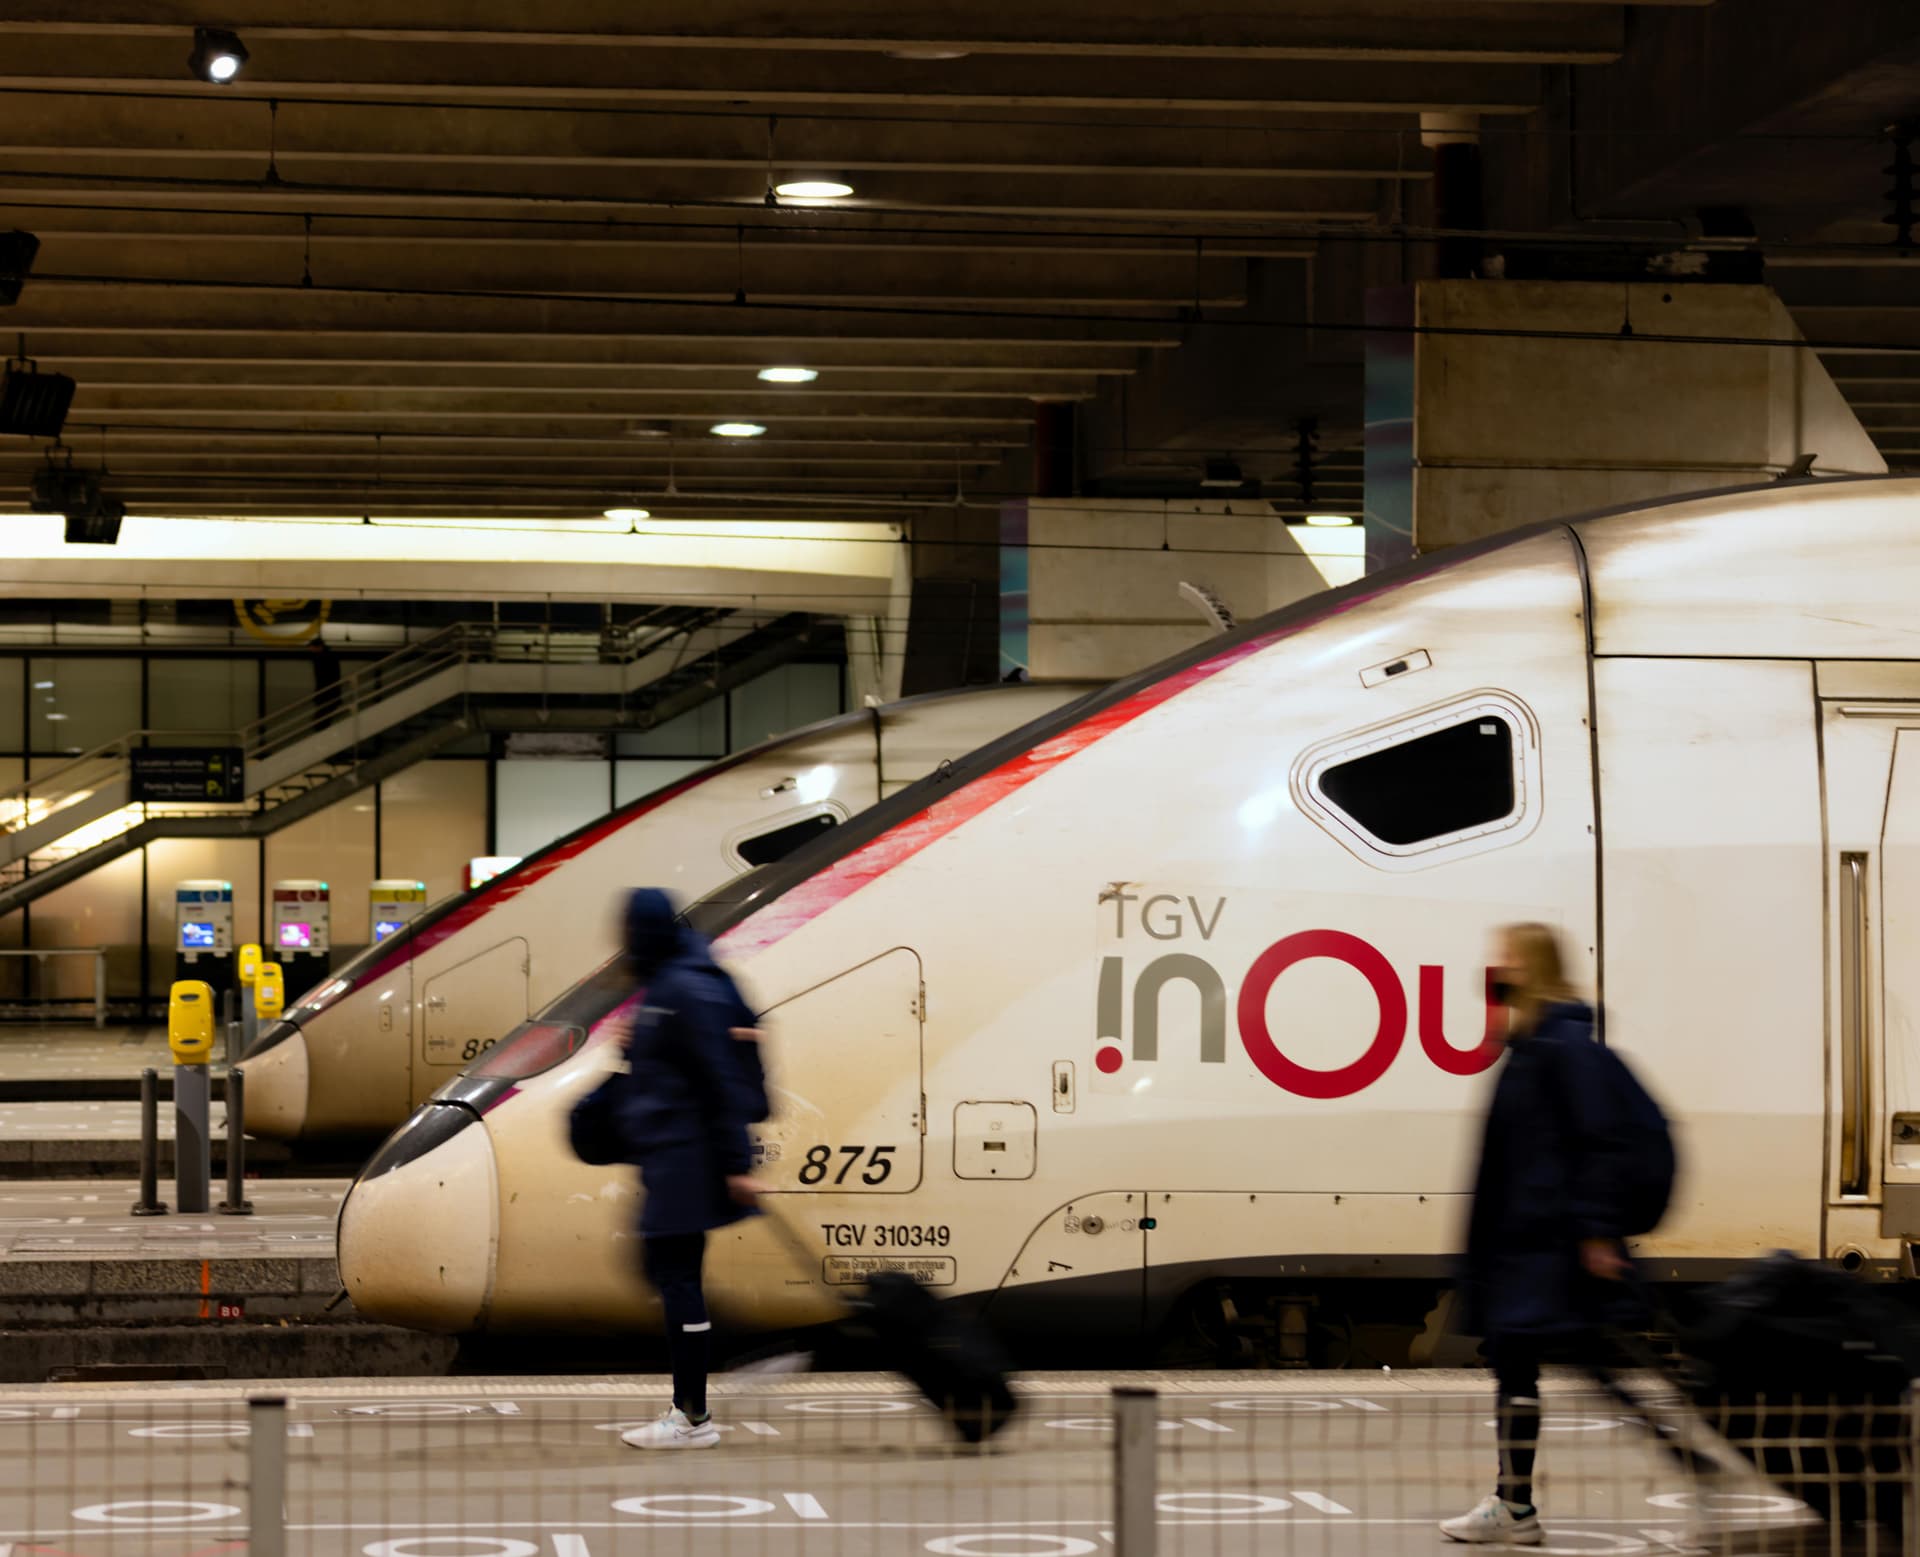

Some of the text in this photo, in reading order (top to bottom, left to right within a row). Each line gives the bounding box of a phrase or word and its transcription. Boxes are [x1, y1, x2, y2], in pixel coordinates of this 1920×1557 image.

[1103, 894, 1227, 941] TGV
[1095, 928, 1510, 1100] inOu
[798, 1144, 896, 1185] 875
[822, 1224, 950, 1247] TGV 310349
